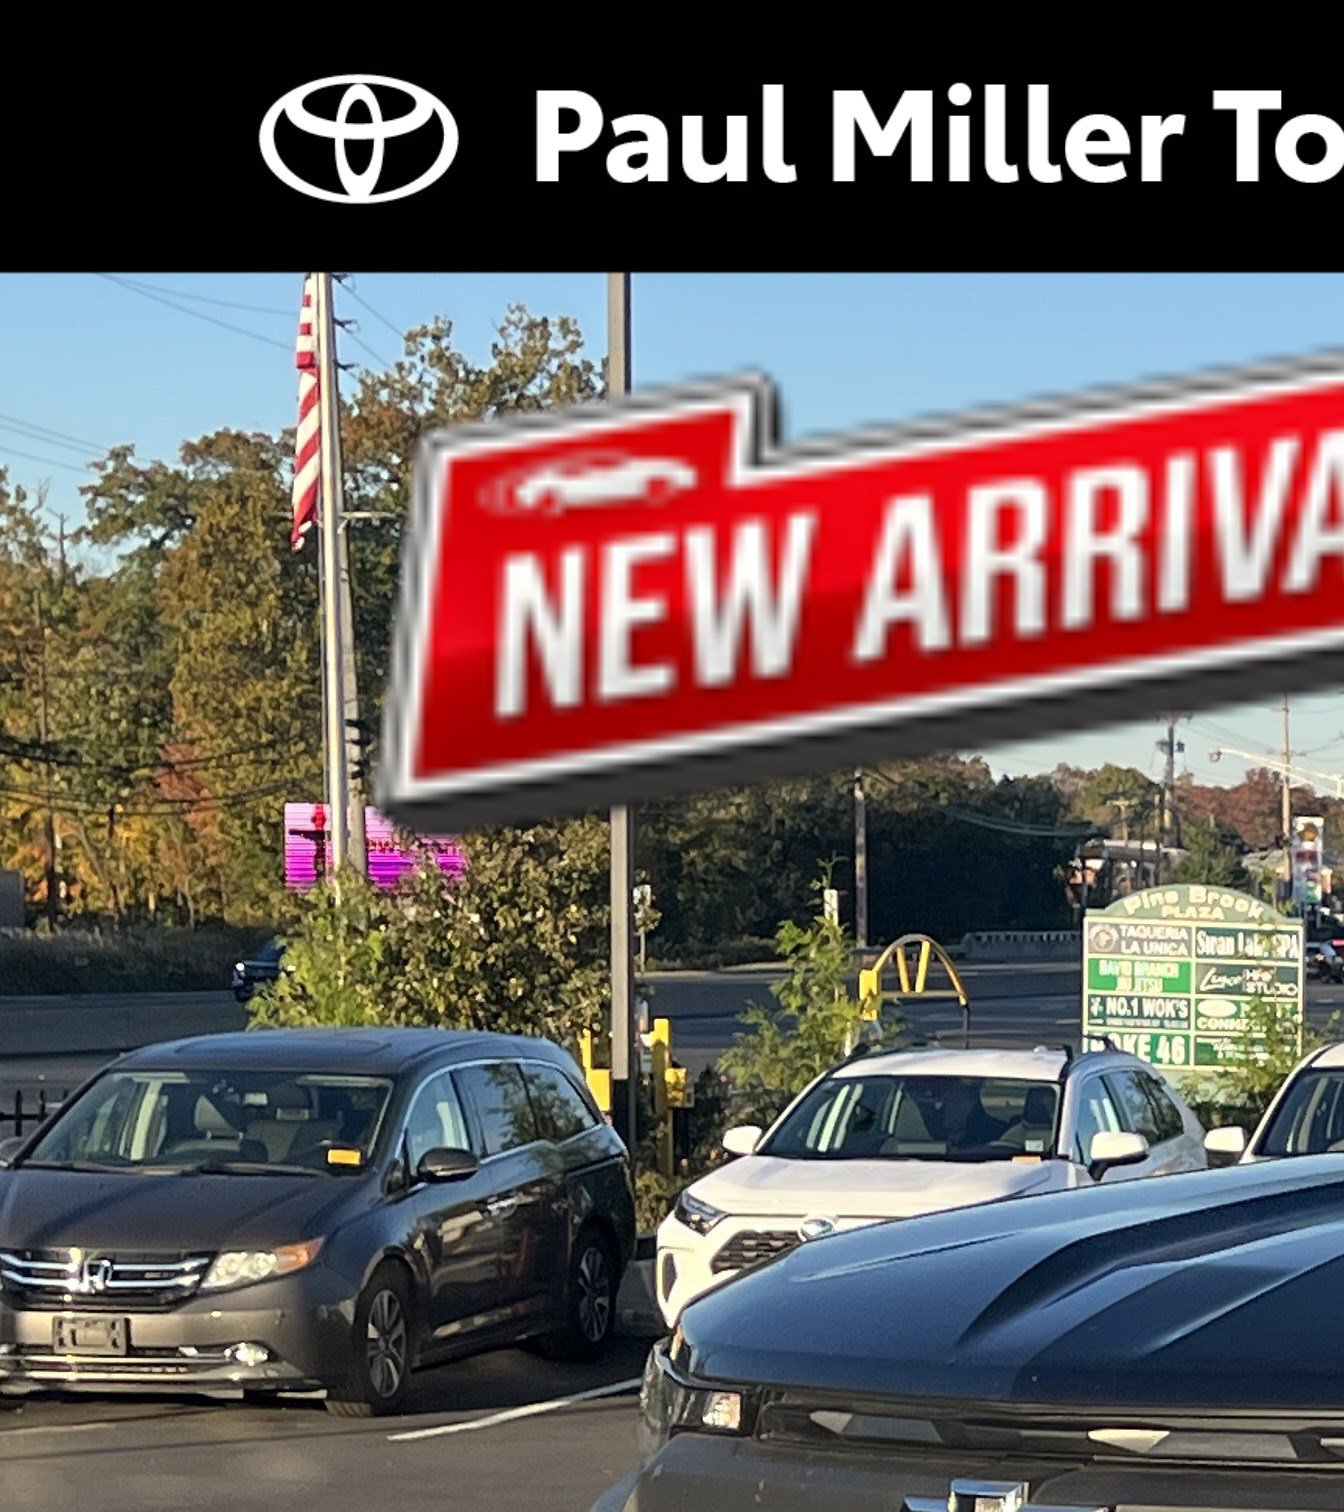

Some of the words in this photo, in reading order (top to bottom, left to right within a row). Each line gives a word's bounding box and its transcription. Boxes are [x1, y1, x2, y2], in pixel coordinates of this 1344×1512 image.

[1123, 889, 1179, 915] Pine
[1188, 885, 1264, 919] Brook
[1161, 906, 1225, 920] PLAZA
[1120, 925, 1188, 941] TAQUERIA
[1121, 940, 1141, 954] LA
[1156, 1035, 1186, 1065] 46
